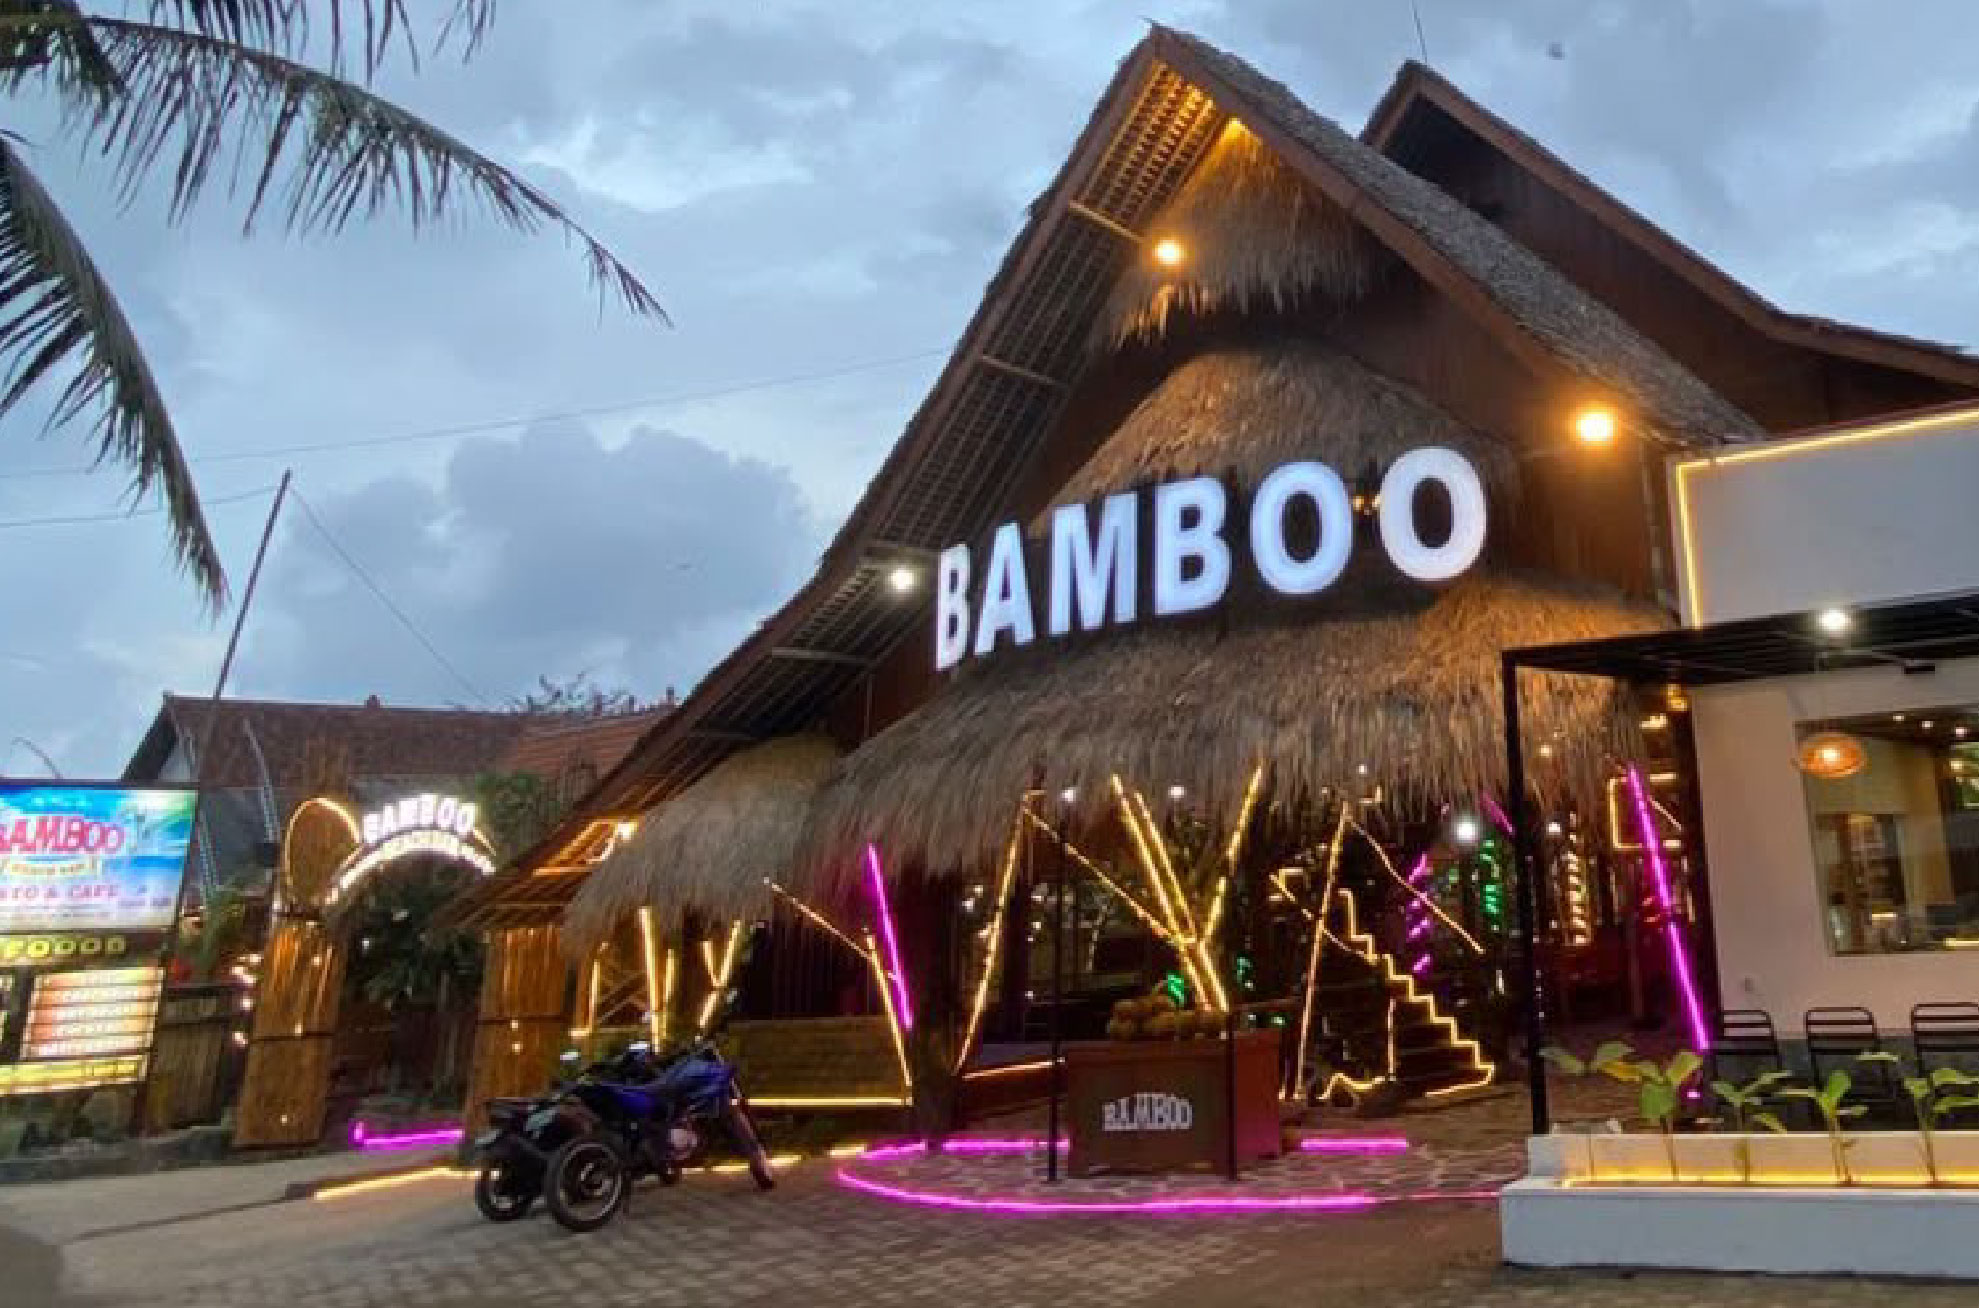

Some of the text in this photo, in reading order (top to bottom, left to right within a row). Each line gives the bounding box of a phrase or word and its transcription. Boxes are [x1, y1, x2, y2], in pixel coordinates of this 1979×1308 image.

[936, 445, 1488, 671] BAMBOO
[361, 792, 477, 845] BAMBOO
[1102, 1092, 1193, 1132] BAMBOO
